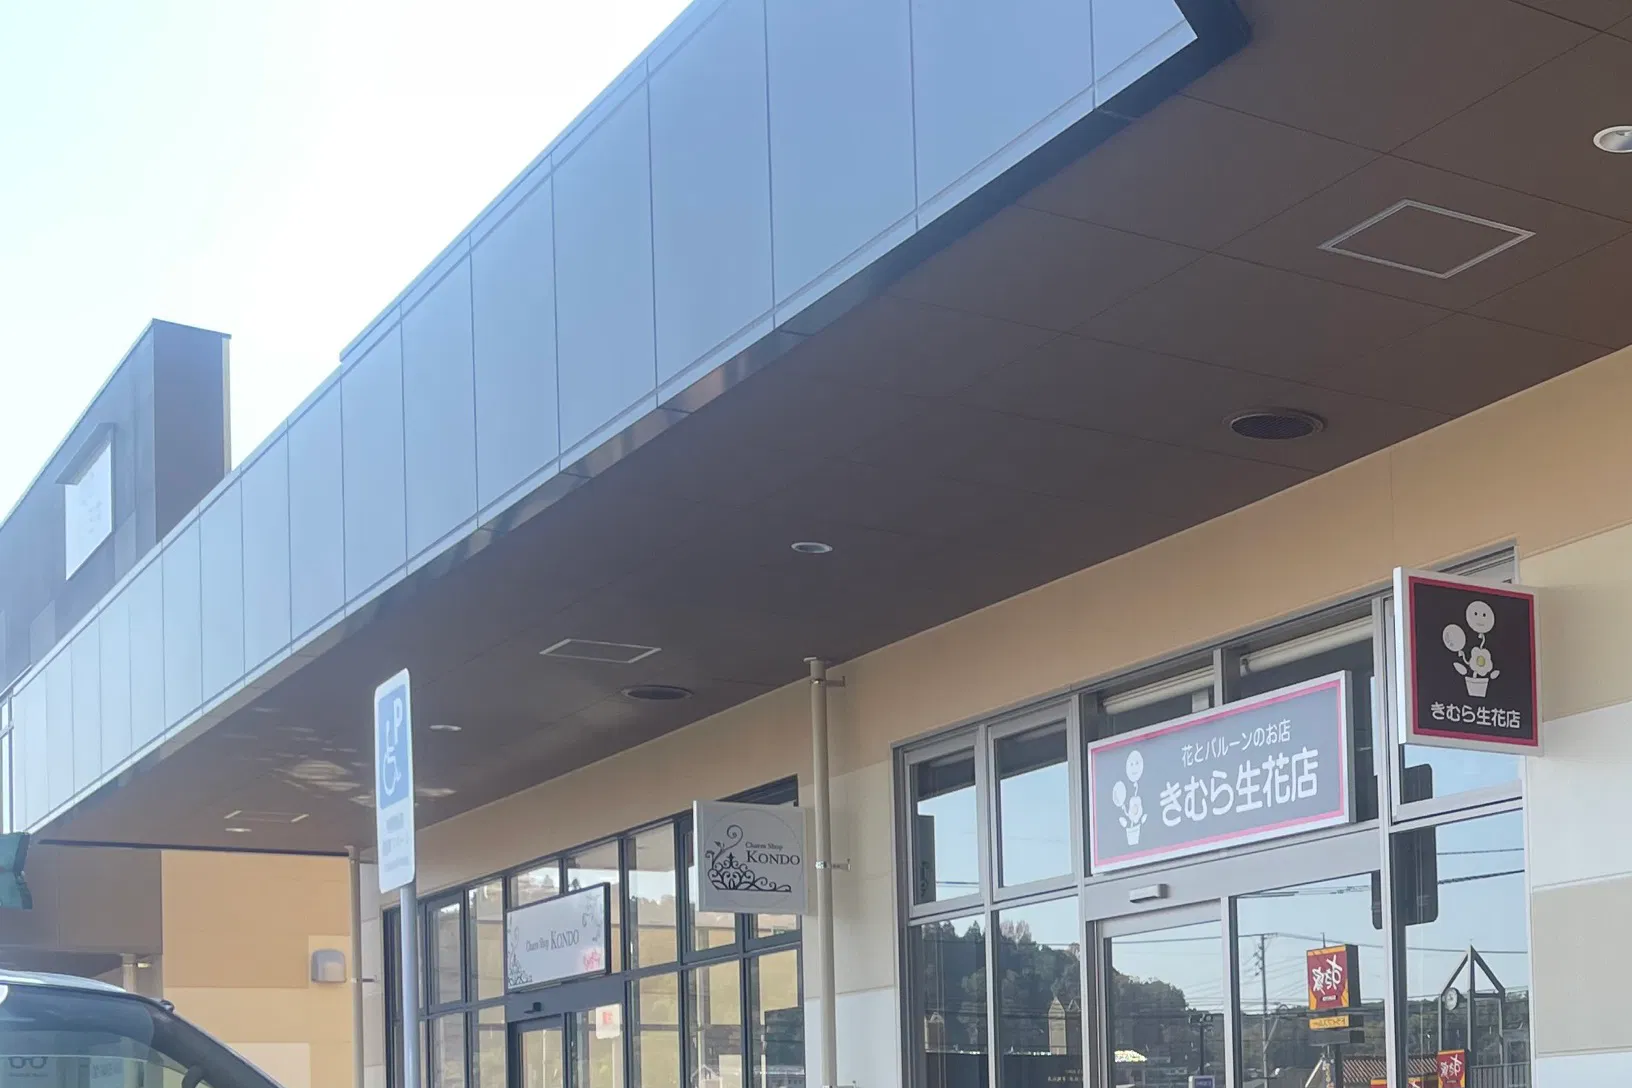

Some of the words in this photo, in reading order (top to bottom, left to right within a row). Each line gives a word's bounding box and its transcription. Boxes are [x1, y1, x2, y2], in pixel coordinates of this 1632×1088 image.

[394, 697, 403, 745] P
[1431, 701, 1521, 729] きむら生花店
[1181, 719, 1291, 767] 花とバルーンのお店
[1159, 746, 1319, 827] きむら生花店
[746, 850, 800, 865] KONDO
[550, 929, 580, 949] KONDO
